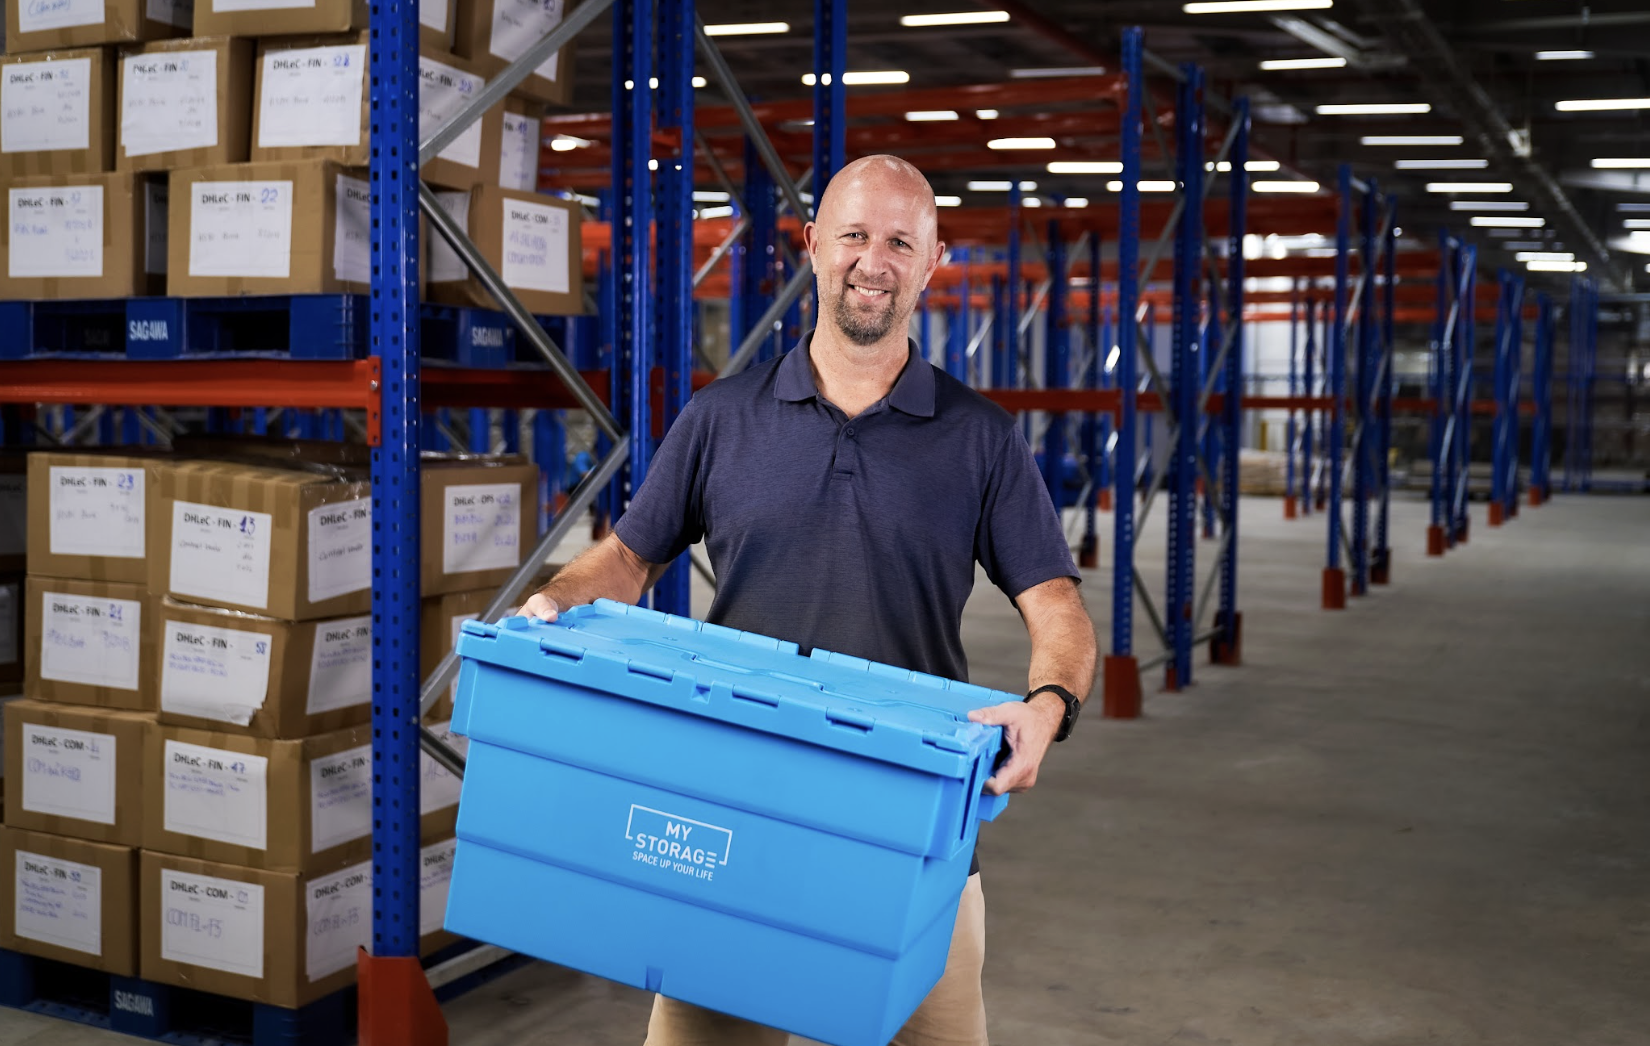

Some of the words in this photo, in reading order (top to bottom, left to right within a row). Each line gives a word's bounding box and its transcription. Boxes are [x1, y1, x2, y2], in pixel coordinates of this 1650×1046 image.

[164, 61, 178, 73] FIN
[272, 57, 301, 70] DHLeC
[307, 58, 322, 69] FIN
[40, 70, 54, 82] FIN
[440, 74, 453, 87] FIN
[49, 196, 65, 208] FIN
[201, 191, 231, 204] DHLeC
[236, 192, 251, 204] FIN
[260, 186, 279, 204] 22
[534, 212, 549, 225] COM
[129, 318, 169, 342] SAGAWA
[60, 475, 87, 488] DHLeC
[93, 476, 107, 488] FIN
[183, 511, 211, 527] DHLeC
[217, 516, 233, 529] FIN
[320, 511, 348, 527] DHLeC
[353, 508, 367, 520] FIN
[86, 605, 101, 618] FIN
[176, 632, 206, 647] DHLeC
[211, 636, 229, 650] FIN
[356, 626, 369, 638] FIN
[63, 738, 85, 751] COM
[173, 752, 202, 767] DHLeC
[208, 759, 224, 771] FIN
[320, 761, 348, 778] DHLeC
[351, 756, 366, 770] FIN
[665, 821, 693, 842] MY
[635, 832, 718, 869] STORAGE
[632, 850, 659, 867] SPACE
[659, 858, 672, 869] UP
[672, 861, 695, 877] YOUR
[695, 868, 714, 882] LIFE
[344, 873, 364, 888] COM
[170, 880, 200, 895] DHLeC
[205, 886, 229, 900] COM
[114, 989, 154, 1017] SAGAWA
